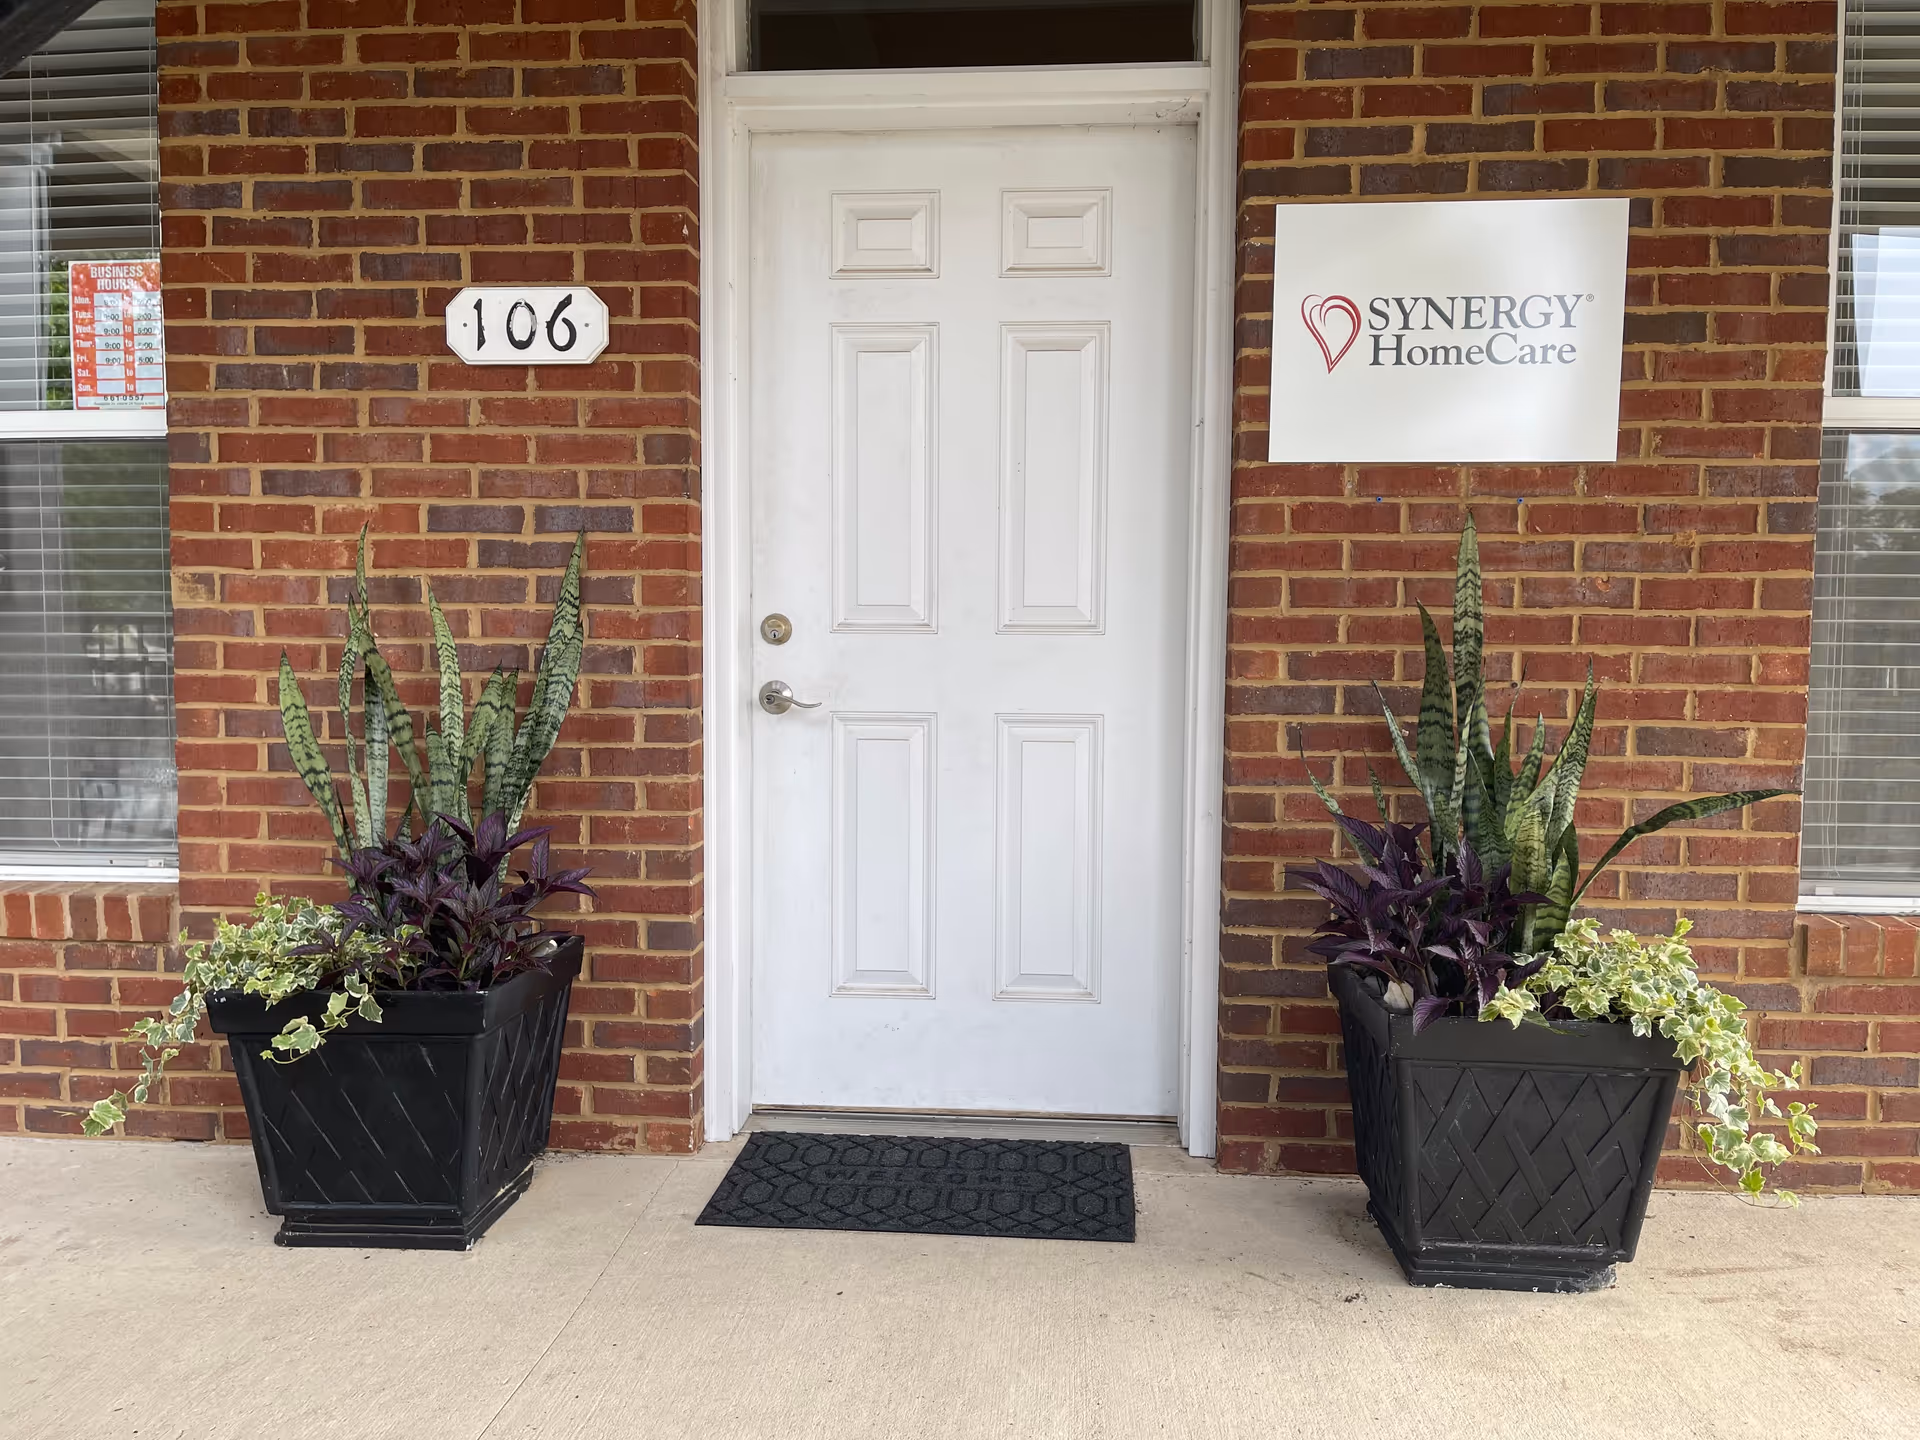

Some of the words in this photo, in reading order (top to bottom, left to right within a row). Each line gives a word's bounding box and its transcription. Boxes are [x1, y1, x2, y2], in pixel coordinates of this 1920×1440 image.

[91, 266, 143, 278] BUSINESS
[97, 279, 134, 290] HOURS
[473, 293, 577, 352] 106
[124, 325, 132, 333] to
[125, 339, 133, 347] to
[1368, 332, 1577, 366] HomeCare
[76, 354, 89, 363] Fri.
[125, 354, 133, 362] to
[77, 368, 91, 377] Sat.
[126, 368, 134, 377] to
[77, 383, 93, 392] Sun.
[126, 383, 134, 391] to
